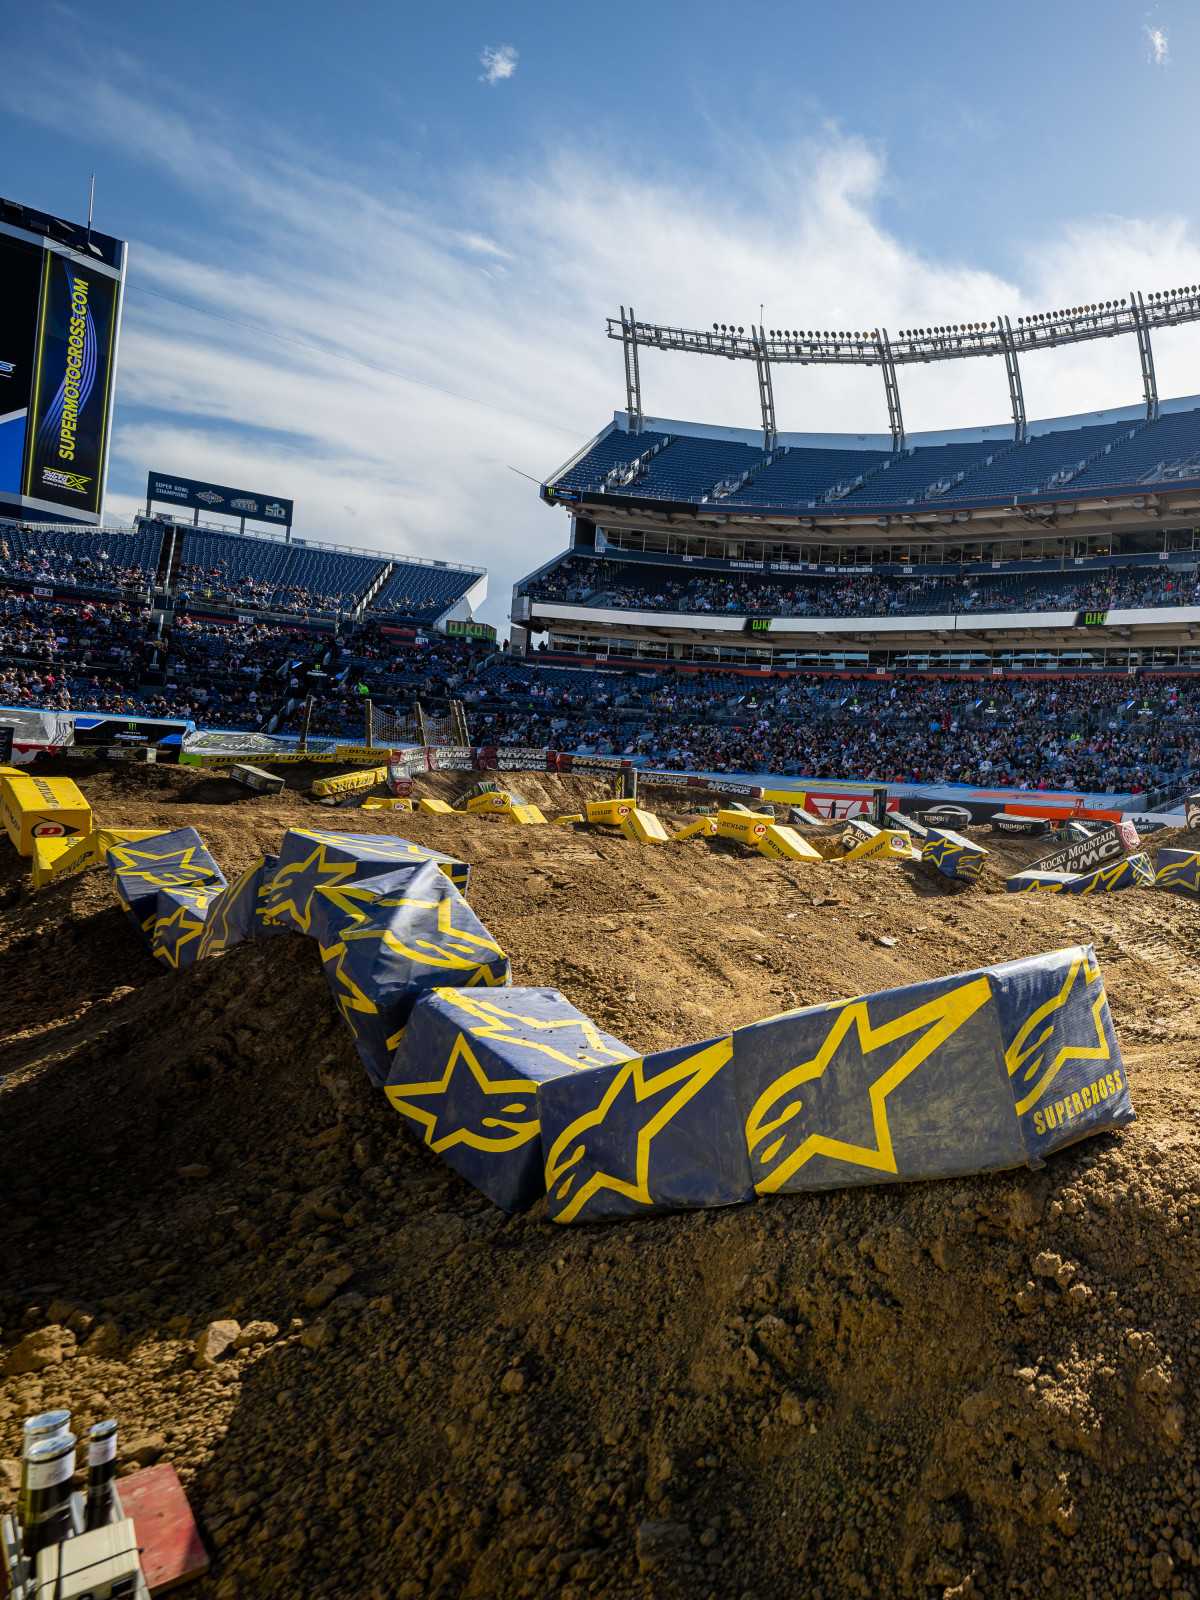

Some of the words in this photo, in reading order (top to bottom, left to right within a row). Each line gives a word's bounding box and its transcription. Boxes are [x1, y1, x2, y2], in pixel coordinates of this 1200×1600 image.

[59, 277, 89, 461] SUPERMOTOCROSS.COM
[155, 481, 173, 490] SUPER
[174, 485, 189, 494] BOWL
[155, 488, 188, 499] CHAMPIONS
[35, 587, 51, 595] 134
[349, 748, 385, 756] DUNLOP
[627, 820, 641, 841] DUNLO
[722, 821, 749, 831] DUNLOP
[998, 822, 1026, 830] TRIUMPH
[767, 840, 791, 860] DUNLO
[858, 841, 886, 860] UNLOP
[1040, 852, 1067, 871] ROCKY
[1068, 828, 1117, 860] MOUNTAIN
[1033, 1069, 1123, 1135] SUPERCROSS
